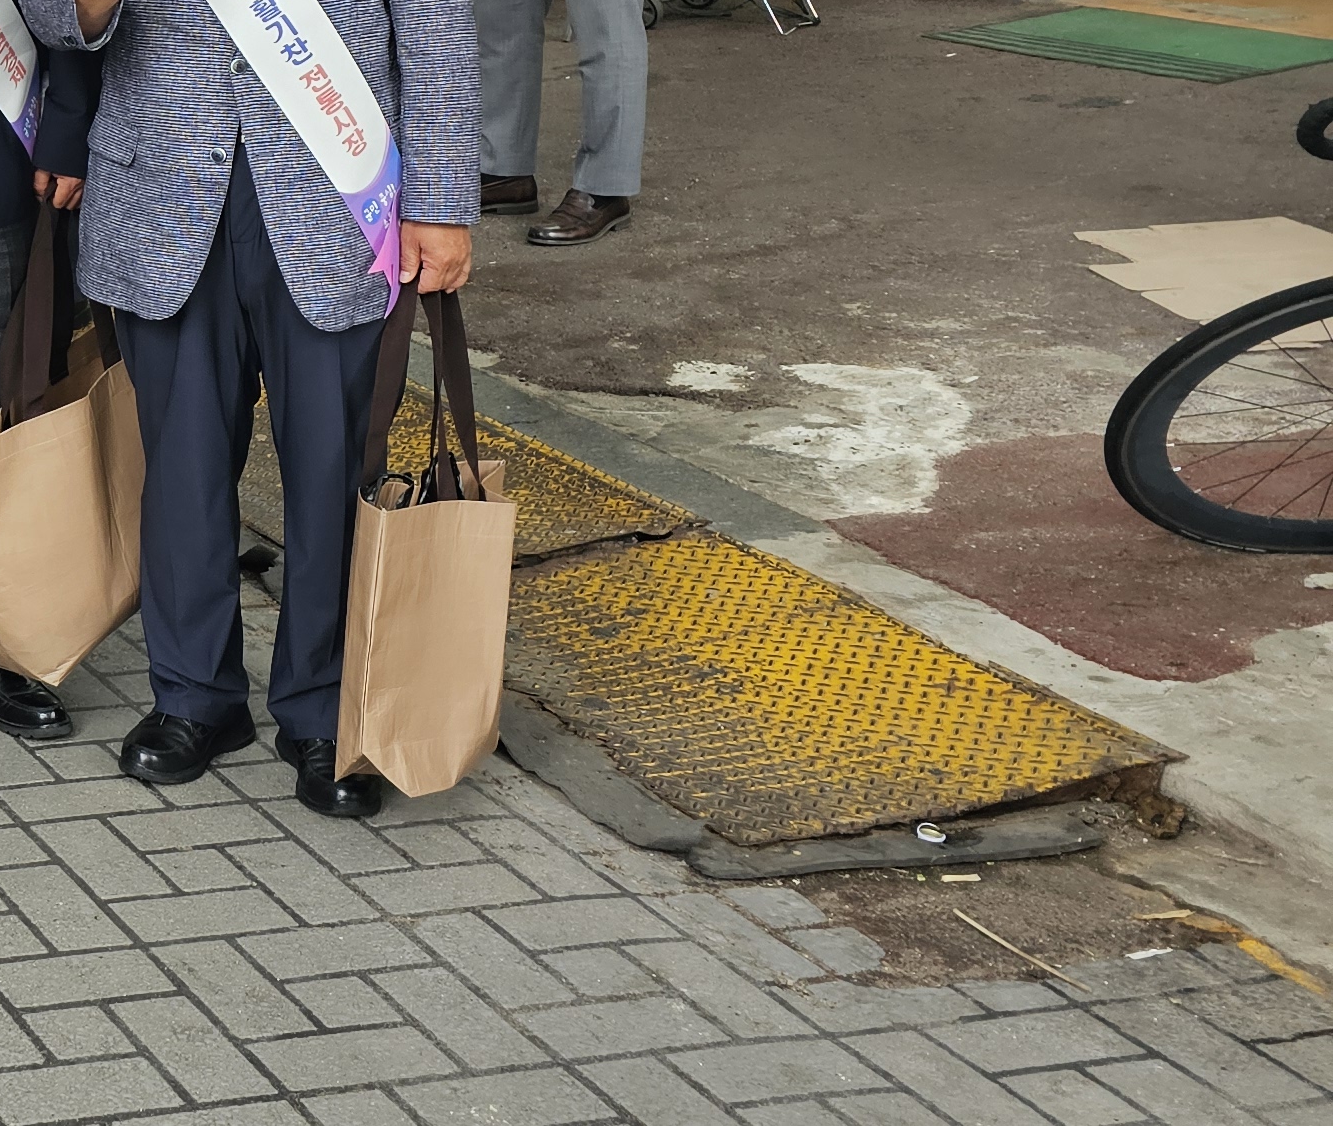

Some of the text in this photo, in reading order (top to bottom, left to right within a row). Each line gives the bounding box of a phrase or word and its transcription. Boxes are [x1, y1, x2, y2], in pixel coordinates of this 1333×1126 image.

[299, 63, 368, 158] 전통시장
[363, 183, 396, 223] 군민 중심!
